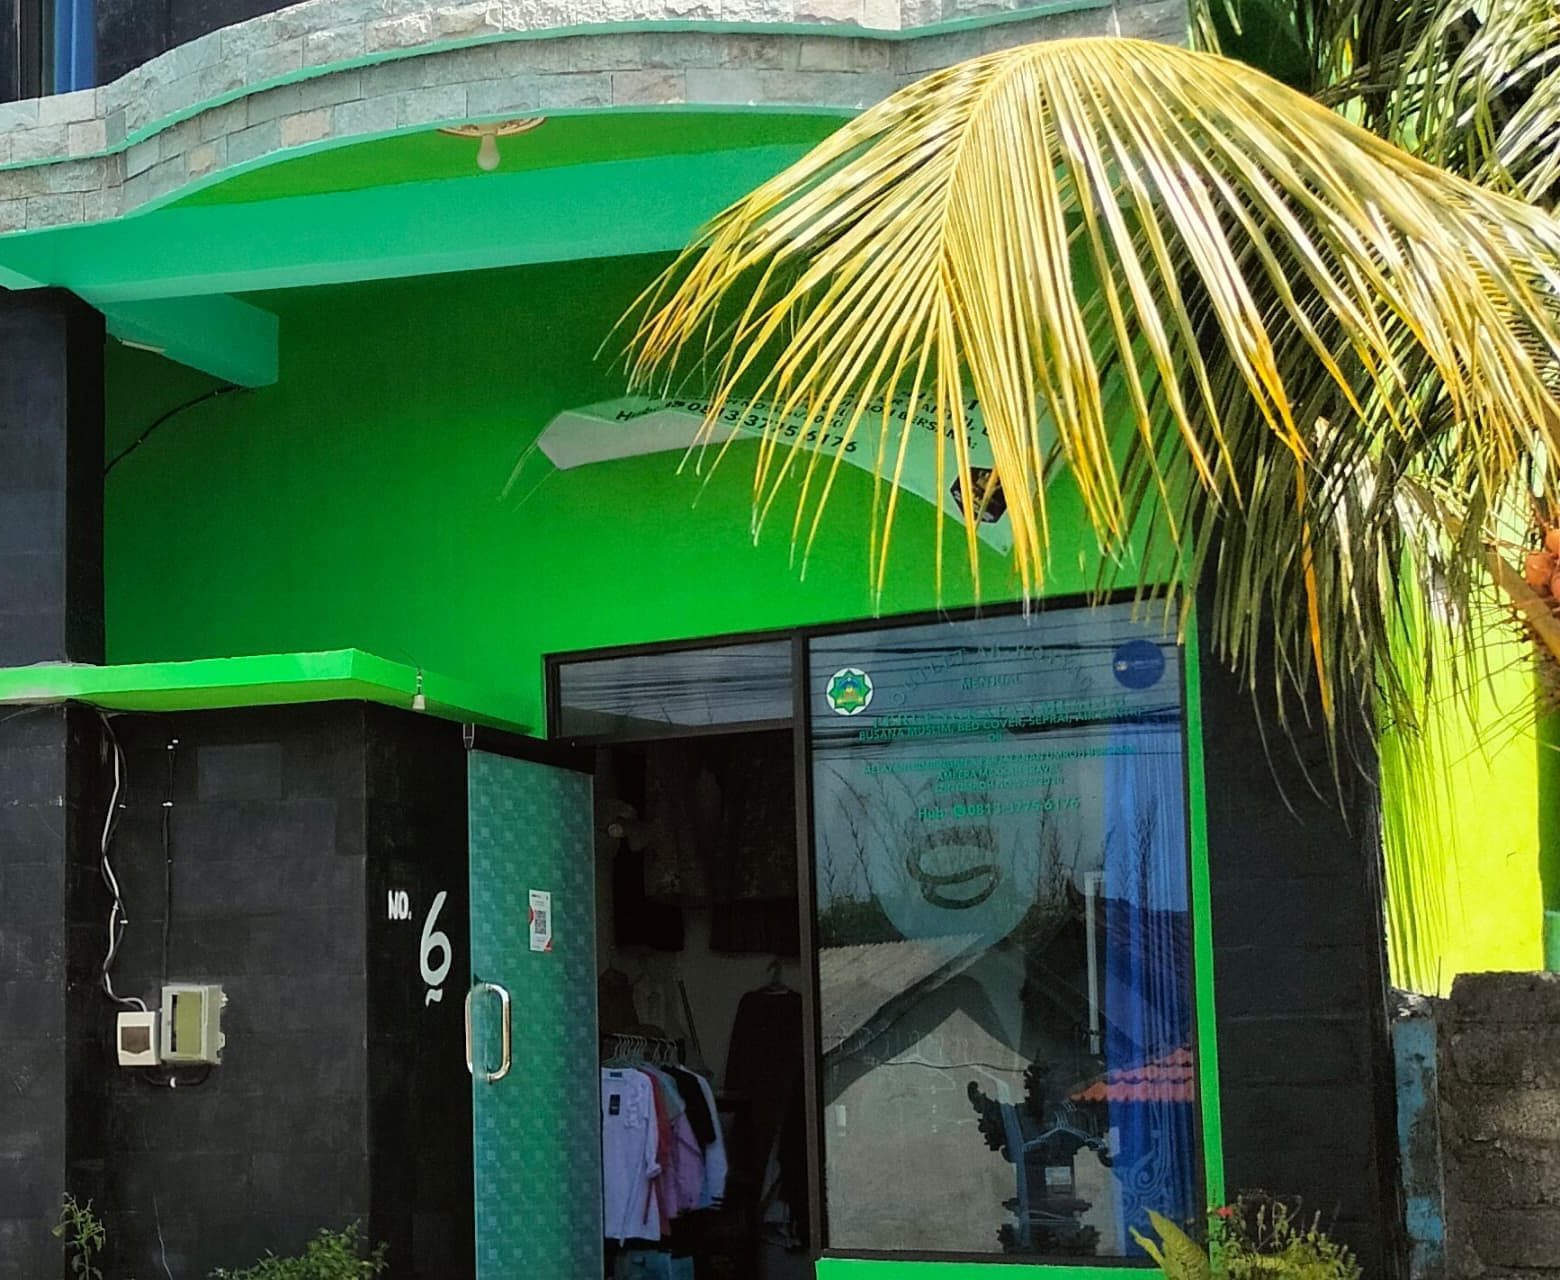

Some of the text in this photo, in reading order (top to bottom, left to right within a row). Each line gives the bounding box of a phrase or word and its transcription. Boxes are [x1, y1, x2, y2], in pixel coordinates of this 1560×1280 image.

[859, 728, 906, 740] BUSANA
[958, 720, 980, 732] BED
[388, 890, 452, 986] NO. 6
